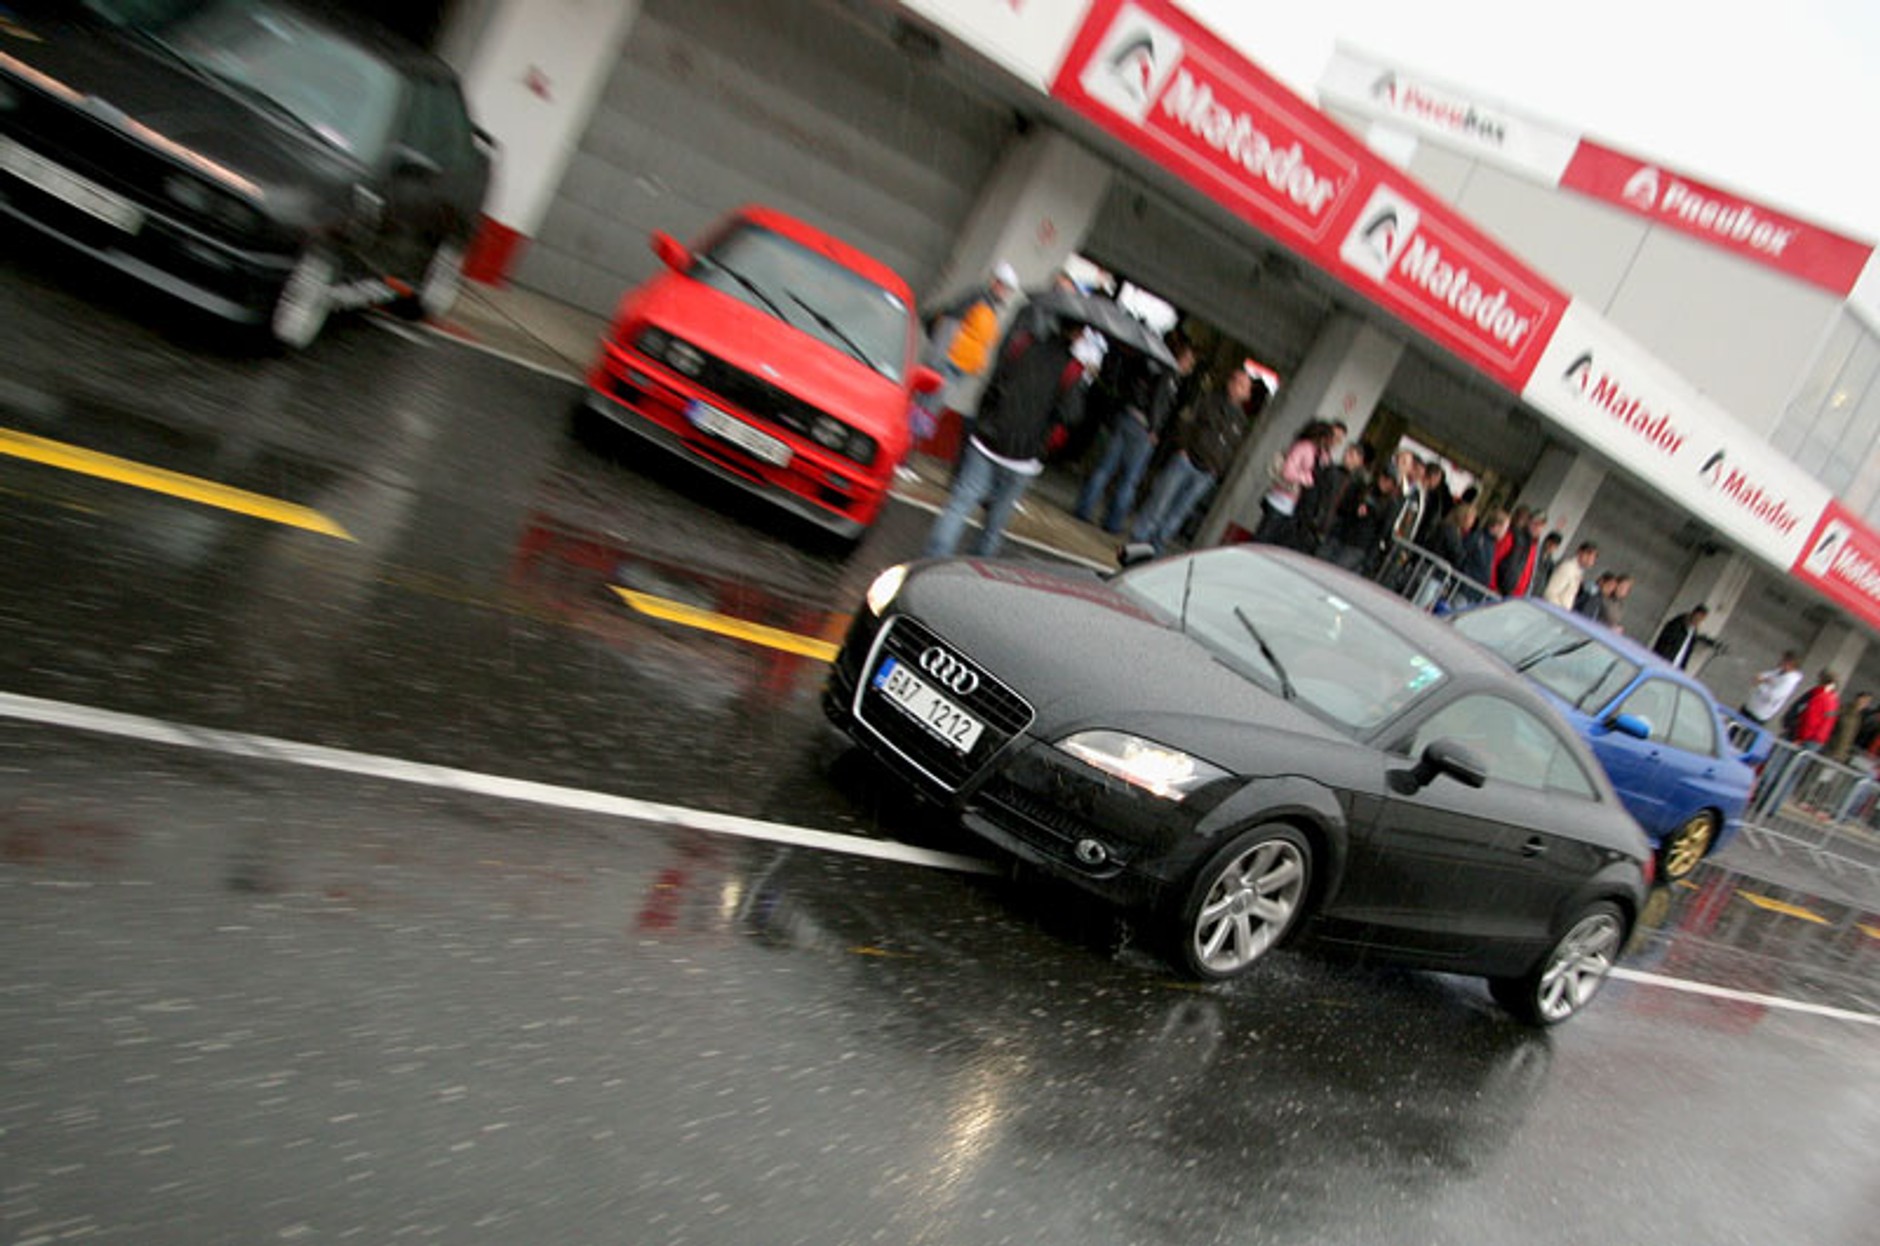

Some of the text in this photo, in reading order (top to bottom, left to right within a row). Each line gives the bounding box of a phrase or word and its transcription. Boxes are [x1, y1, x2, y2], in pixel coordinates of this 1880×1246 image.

[1162, 66, 1335, 216] Matador
[1661, 179, 1791, 258] Pneubox
[1400, 234, 1530, 348] Matador
[1590, 373, 1686, 456] Matador
[1722, 466, 1800, 535] Matador
[928, 698, 973, 744] 1212
